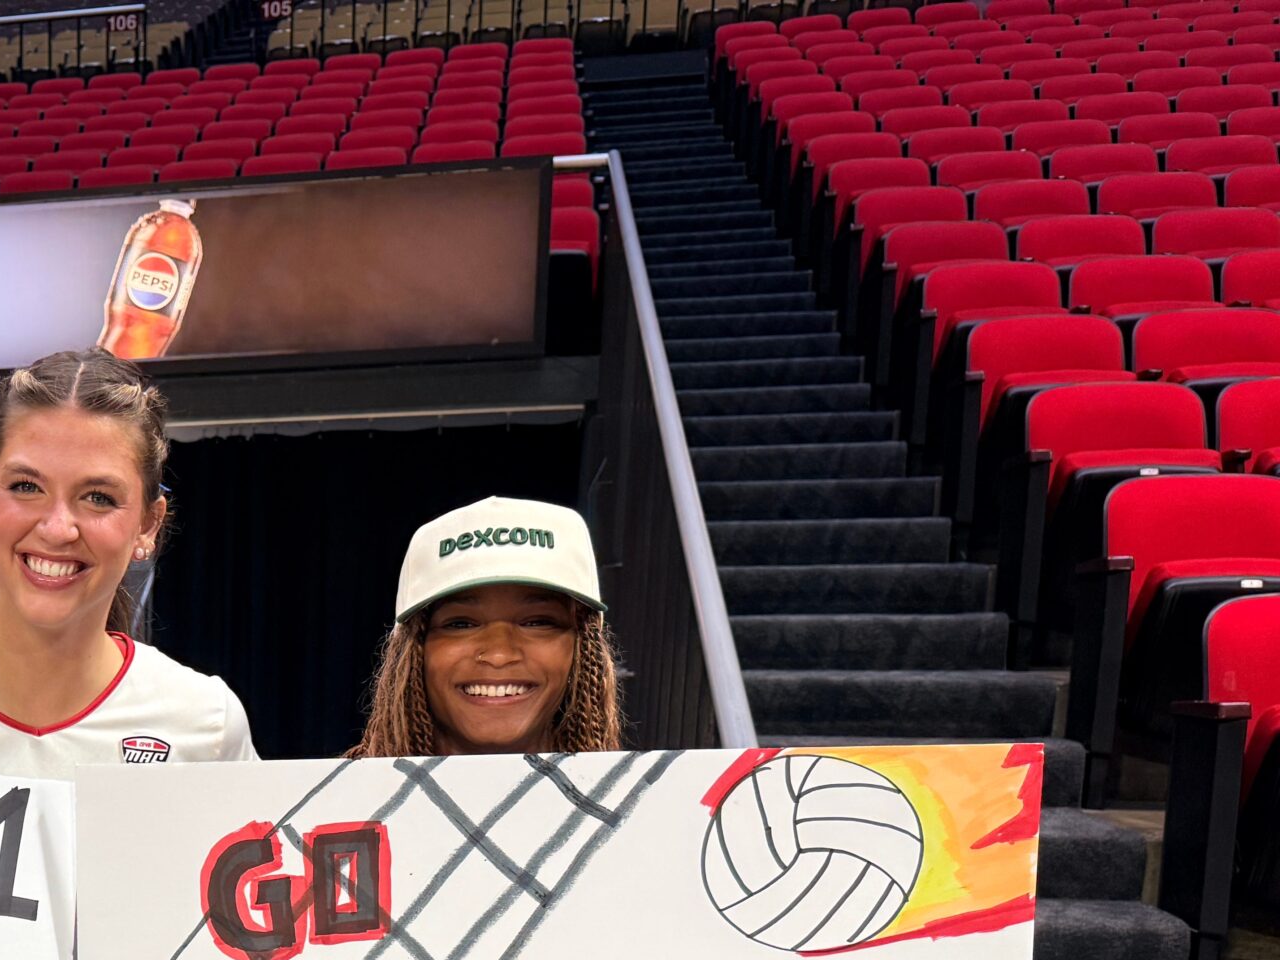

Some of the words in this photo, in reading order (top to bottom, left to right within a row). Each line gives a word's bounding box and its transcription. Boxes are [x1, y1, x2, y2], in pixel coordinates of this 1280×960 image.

[261, 1, 292, 18] 105
[107, 15, 137, 31] 106
[131, 271, 174, 293] PEPSI
